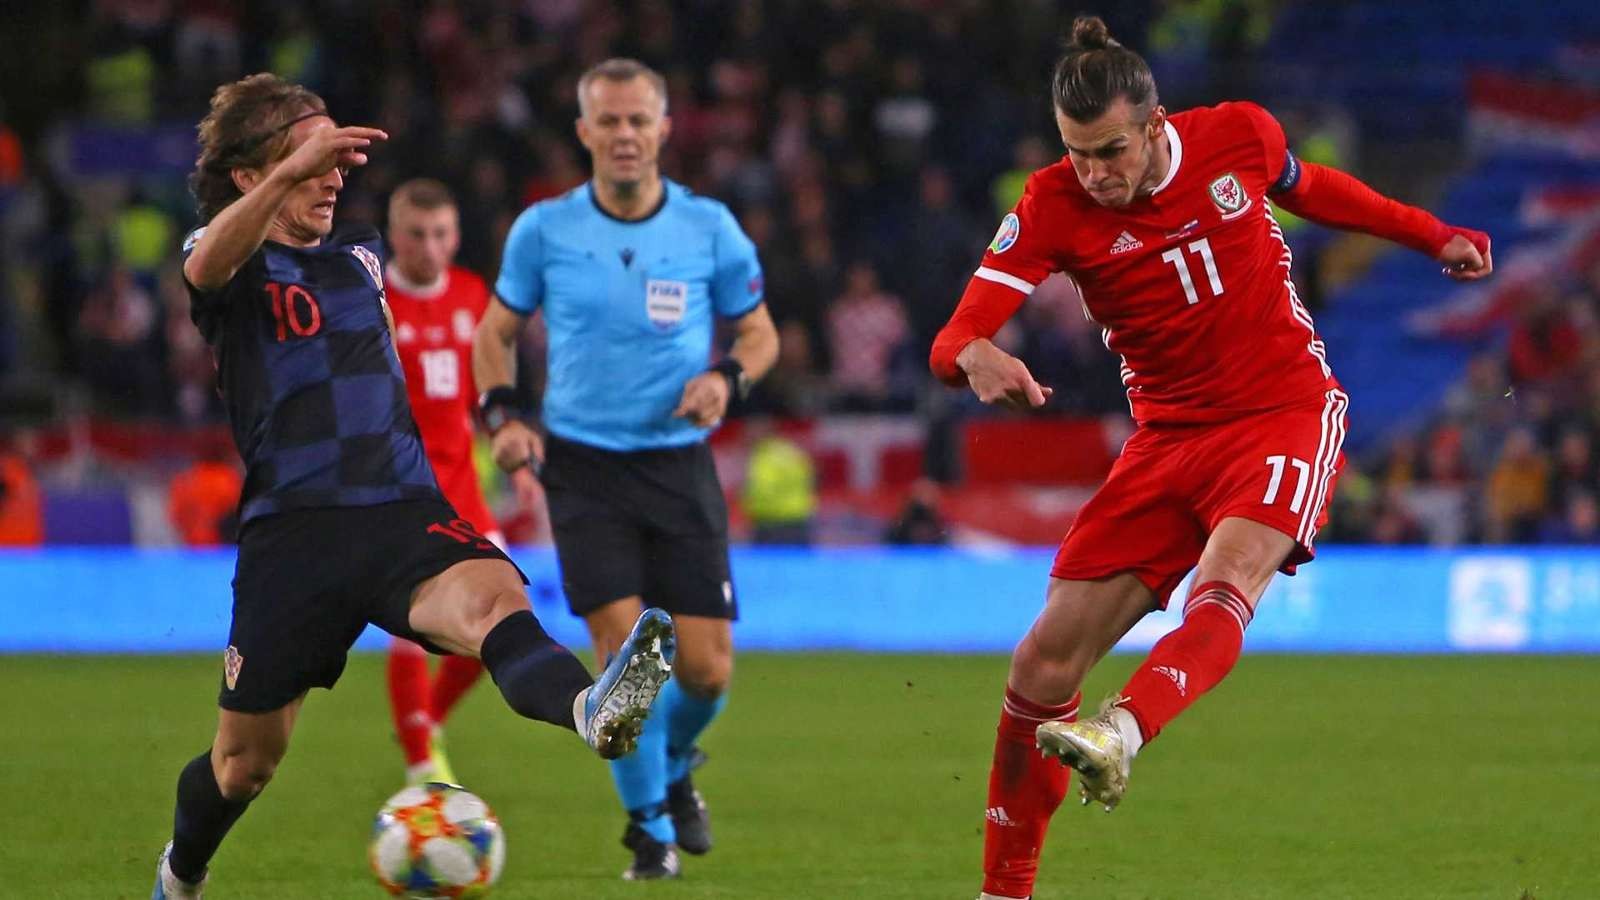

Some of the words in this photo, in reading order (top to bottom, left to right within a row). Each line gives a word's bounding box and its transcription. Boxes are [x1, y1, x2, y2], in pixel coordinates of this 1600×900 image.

[1110, 240, 1144, 254] adidas
[1161, 237, 1224, 304] 11
[265, 282, 320, 342] 10
[1262, 455, 1310, 514] 11
